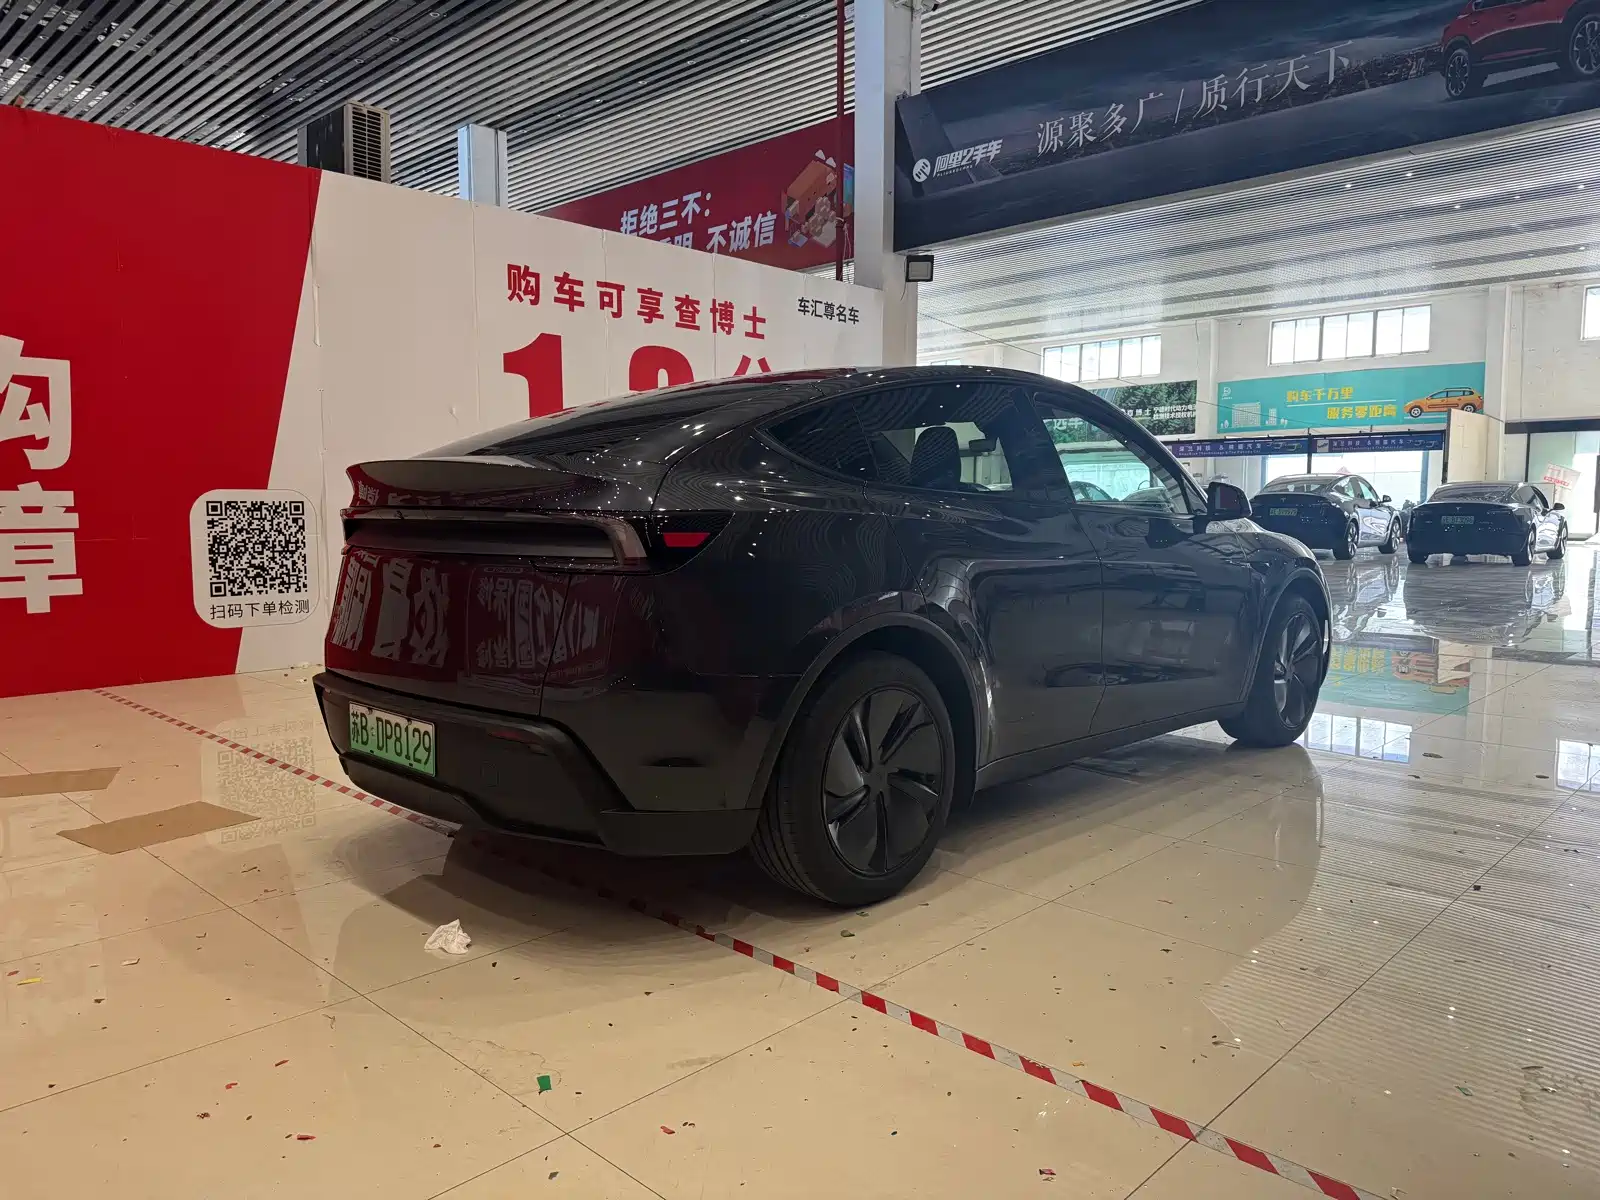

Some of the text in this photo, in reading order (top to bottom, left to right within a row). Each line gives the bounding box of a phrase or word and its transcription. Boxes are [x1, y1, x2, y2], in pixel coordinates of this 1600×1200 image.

[706, 210, 777, 253] 不诚信
[506, 264, 767, 340] 购车可享查博士
[797, 296, 860, 325] 车汇尊名车
[1286, 386, 1354, 402] 购车千万里
[1327, 404, 1397, 419] 服务零距离
[209, 598, 310, 620] 扫码下单检测
